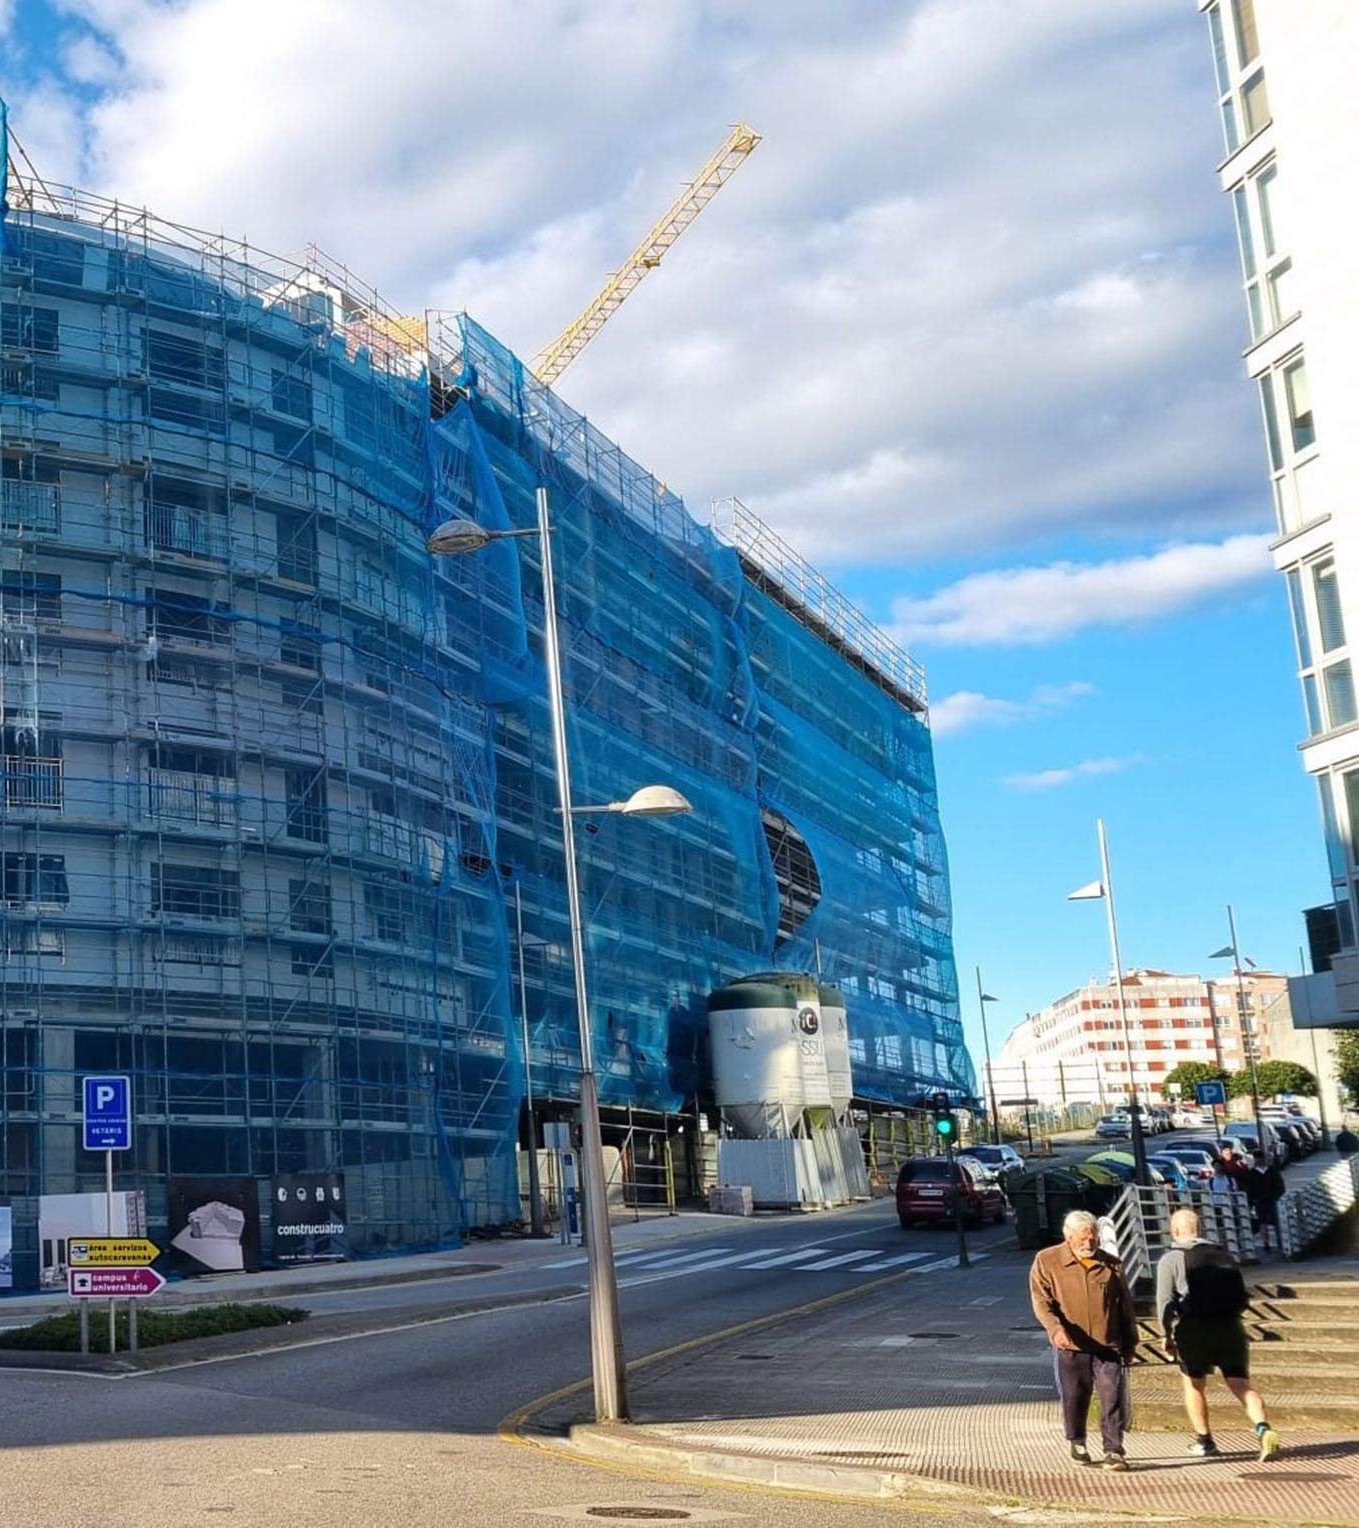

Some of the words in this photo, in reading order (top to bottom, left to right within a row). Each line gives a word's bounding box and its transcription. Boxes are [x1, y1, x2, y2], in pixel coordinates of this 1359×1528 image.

[97, 1085, 115, 1110] P
[1203, 1086, 1217, 1102] P
[277, 1223, 344, 1235] construcuatro
[92, 1274, 127, 1282] campus
[92, 1283, 149, 1291] universitario
